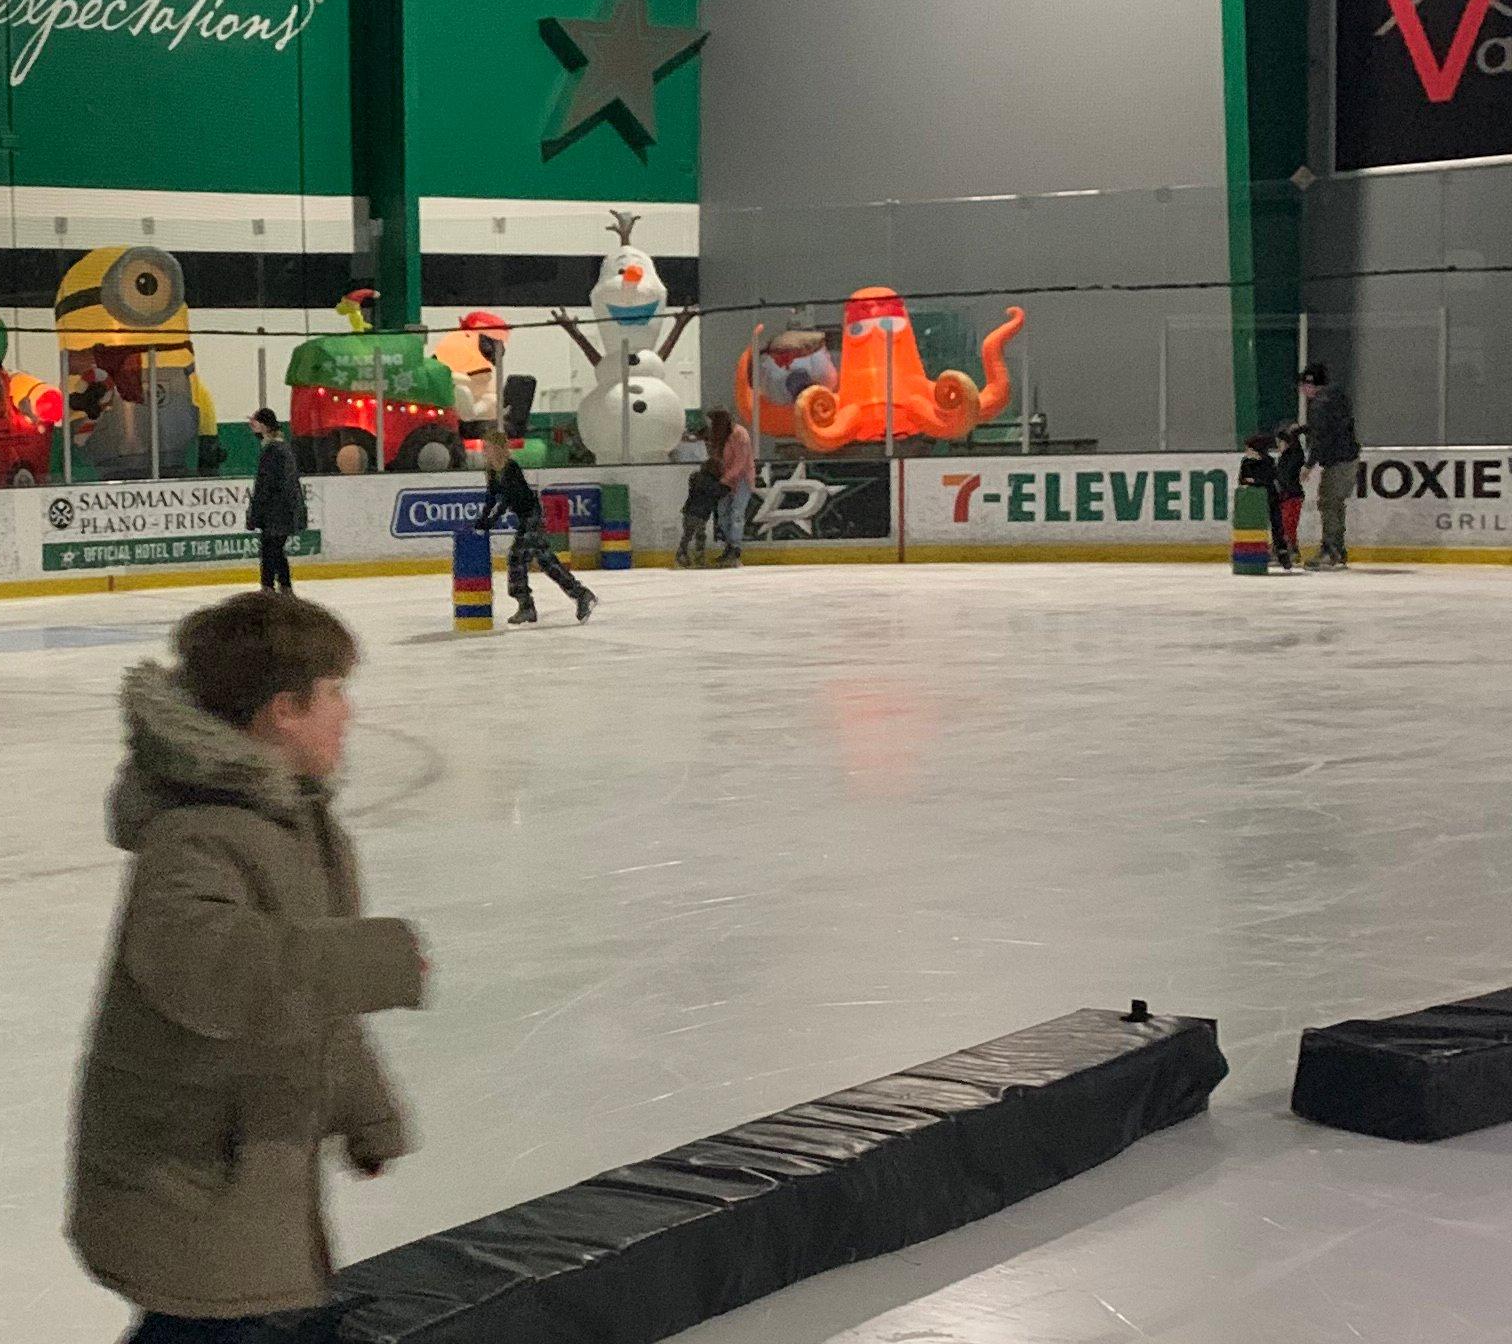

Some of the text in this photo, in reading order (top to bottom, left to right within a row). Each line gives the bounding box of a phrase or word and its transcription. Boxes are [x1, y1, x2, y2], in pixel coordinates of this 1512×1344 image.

[1356, 458, 1512, 499] OXIE
[78, 489, 185, 512] SANDMAN
[80, 515, 147, 534] PLANO
[164, 510, 238, 530] FRISCO
[84, 537, 260, 562] OFFICIAL HOTEL OF THE DALLAS
